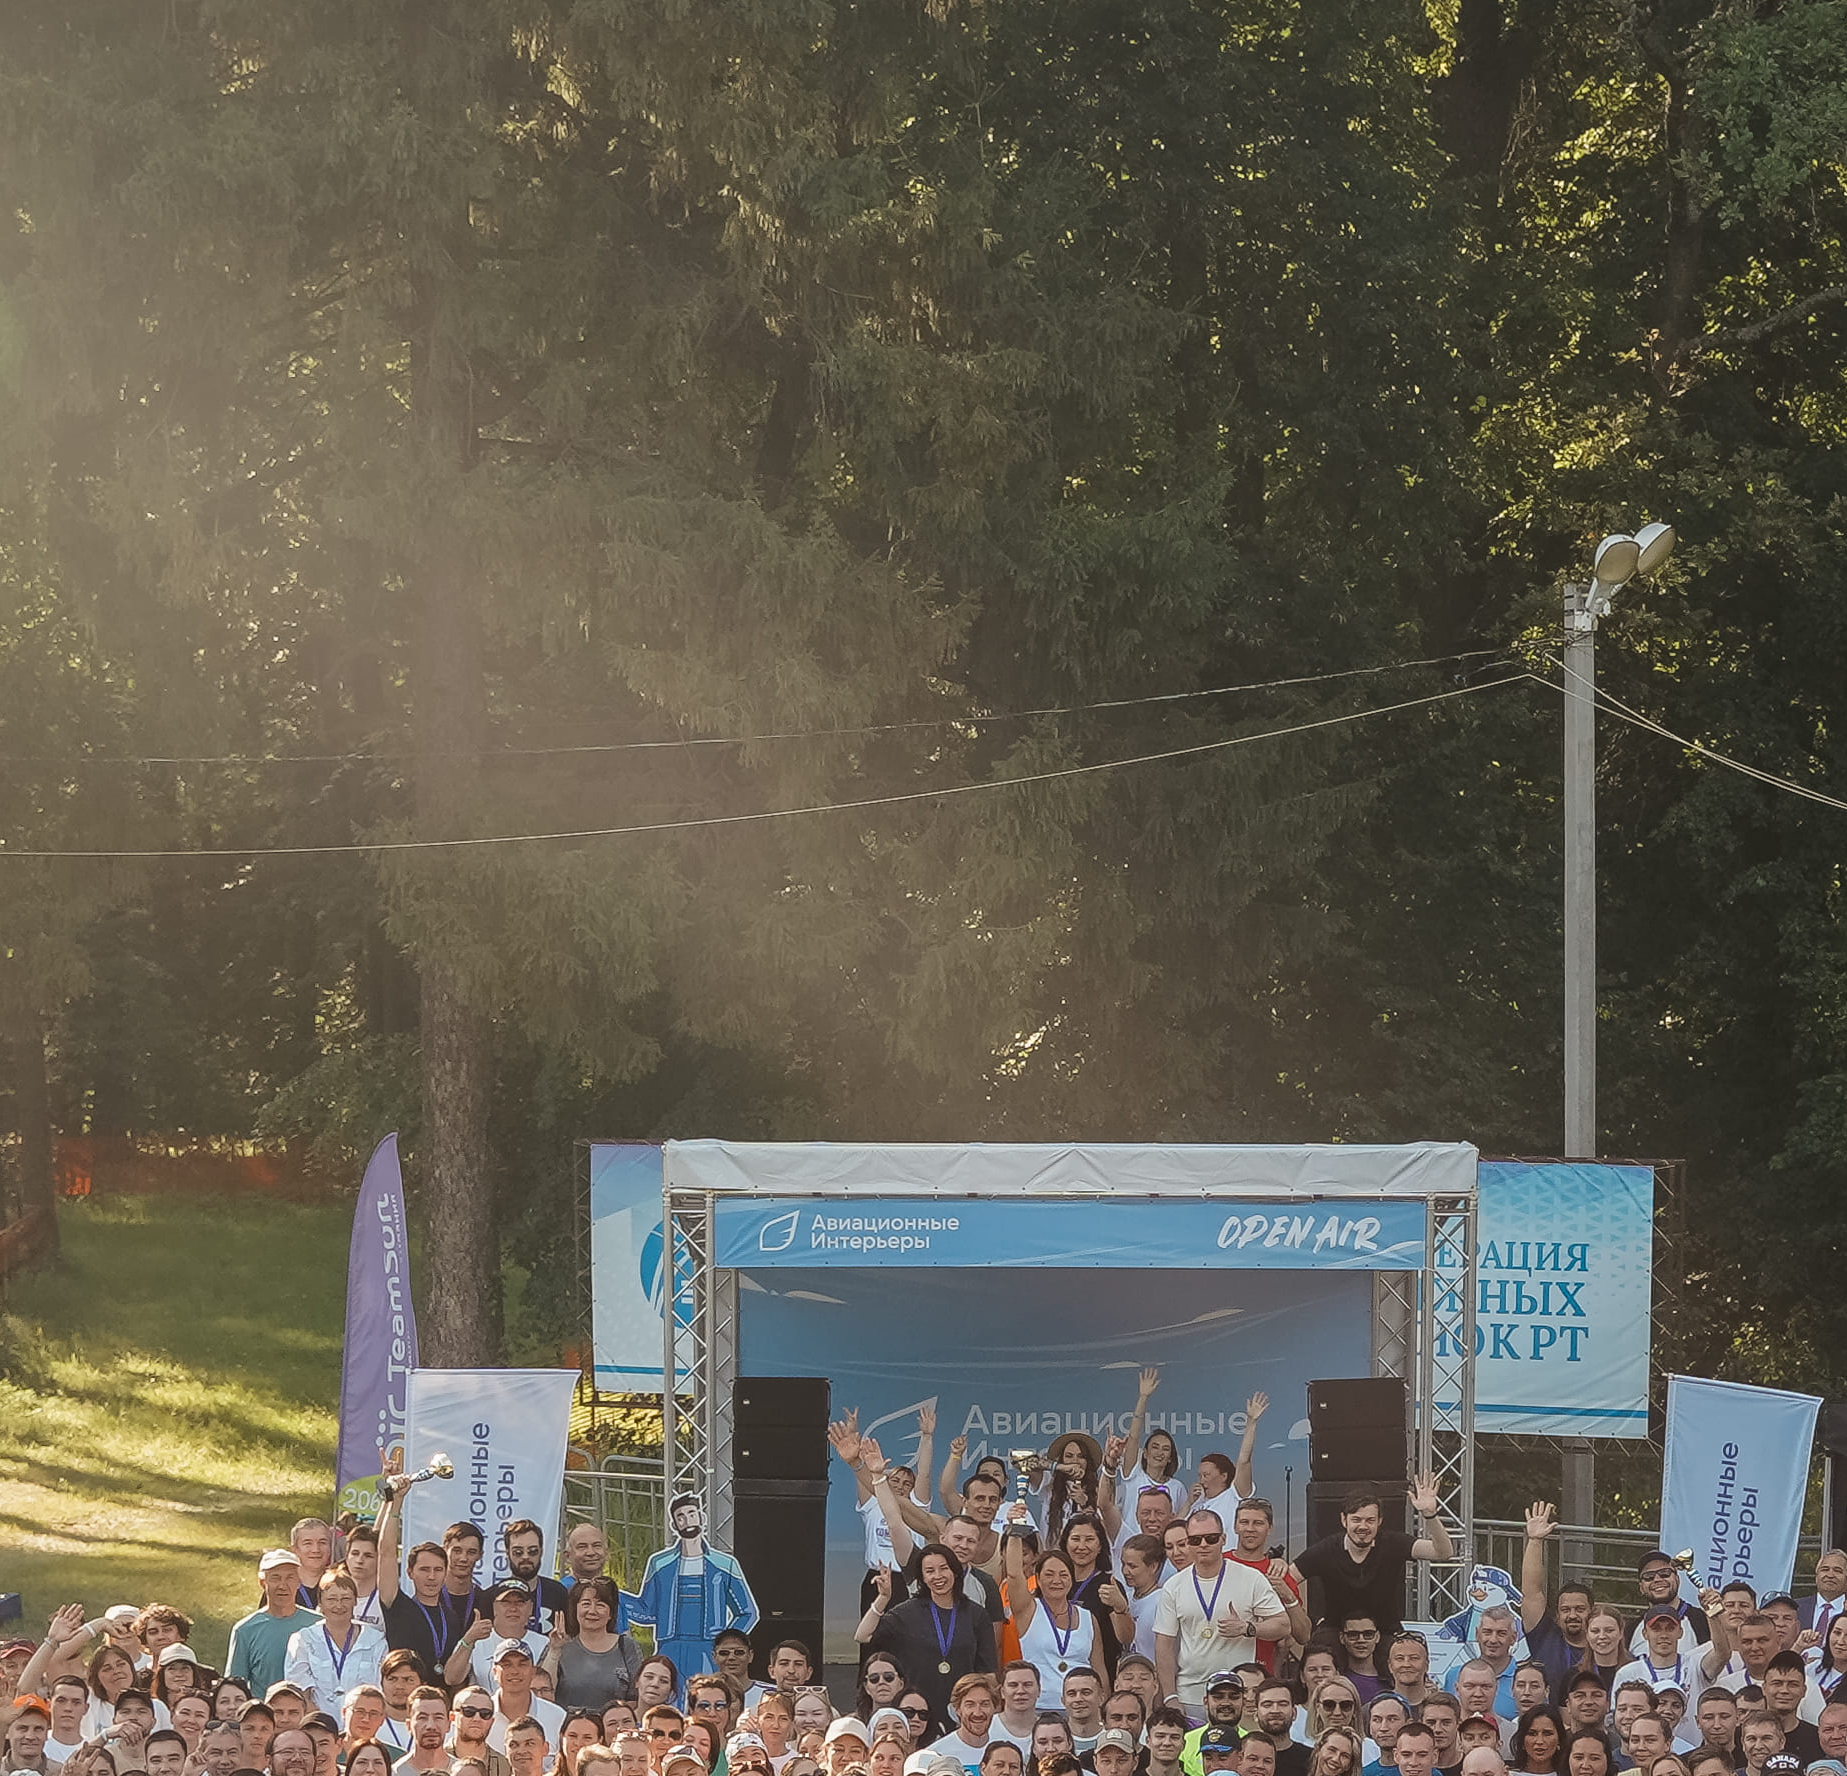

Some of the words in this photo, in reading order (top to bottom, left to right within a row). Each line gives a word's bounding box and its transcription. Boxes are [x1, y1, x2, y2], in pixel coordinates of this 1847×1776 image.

[811, 1214, 960, 1233] Авиационные
[1217, 1215, 1316, 1251] OPEN
[1312, 1216, 1382, 1255] AIR
[811, 1232, 930, 1253] Интерьеры
[1530, 1324, 1589, 1362] РТ
